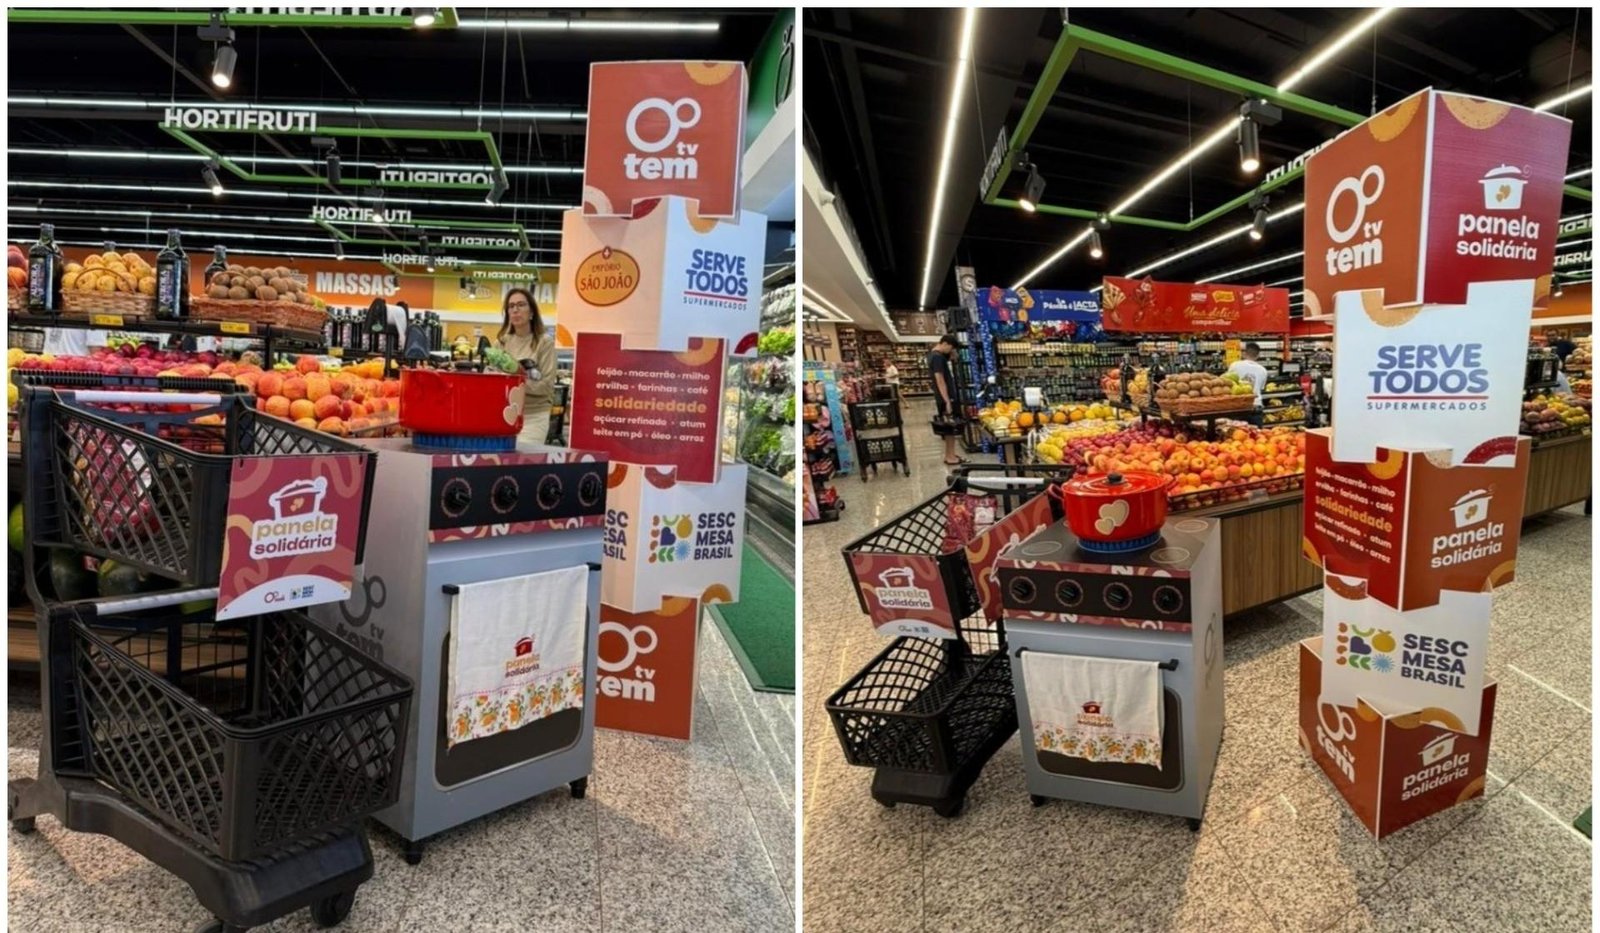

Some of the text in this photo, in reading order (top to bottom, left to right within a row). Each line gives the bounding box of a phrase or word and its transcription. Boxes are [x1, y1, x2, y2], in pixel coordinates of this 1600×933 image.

[164, 108, 317, 132] HORTIFRUTI
[676, 142, 698, 155] tv
[623, 153, 698, 180] tem
[312, 206, 412, 223] HORTIFUTI
[1364, 220, 1383, 238] tv
[1458, 213, 1540, 239] panela
[1326, 237, 1383, 276] tem
[1456, 238, 1537, 261] solidária
[692, 249, 746, 277] SERVE
[316, 271, 396, 297] MASSAS
[580, 272, 633, 291] SÃO JOÃO
[686, 270, 748, 297] TODOS
[683, 297, 748, 311] SUPERMERCADOS
[1377, 343, 1482, 370] SERVE
[597, 368, 710, 381] feijão macarrão milho
[1368, 369, 1489, 394] TODOS
[596, 382, 708, 395] ervilha farinhas café
[595, 395, 707, 413] solidariedade
[1367, 401, 1487, 411] SUPERMERCADOS
[593, 414, 706, 428] açúcar refinado atum
[593, 428, 612, 437] leite
[614, 430, 629, 438] em
[631, 430, 643, 440] pó
[651, 430, 671, 440] óleo
[1372, 485, 1396, 498] milho
[1315, 495, 1393, 533] solidariedade
[1376, 501, 1394, 512] café
[256, 516, 335, 541] panela
[606, 509, 628, 528] SC
[698, 512, 735, 529] SESC
[254, 533, 333, 555] solidária
[696, 530, 734, 547] MESA
[1370, 535, 1392, 550] atum
[1432, 522, 1504, 554] panela
[694, 547, 733, 560] BRASIL
[1430, 541, 1502, 568] solidária
[882, 598, 932, 609] solidária
[1403, 633, 1469, 657] SESC
[635, 665, 656, 680] tv
[1402, 650, 1467, 675] MESA
[596, 675, 655, 702] em
[1401, 667, 1465, 689] BRASIL
[1316, 724, 1356, 784] tem
[1402, 752, 1470, 790] panela
[1402, 766, 1469, 801] solidária
